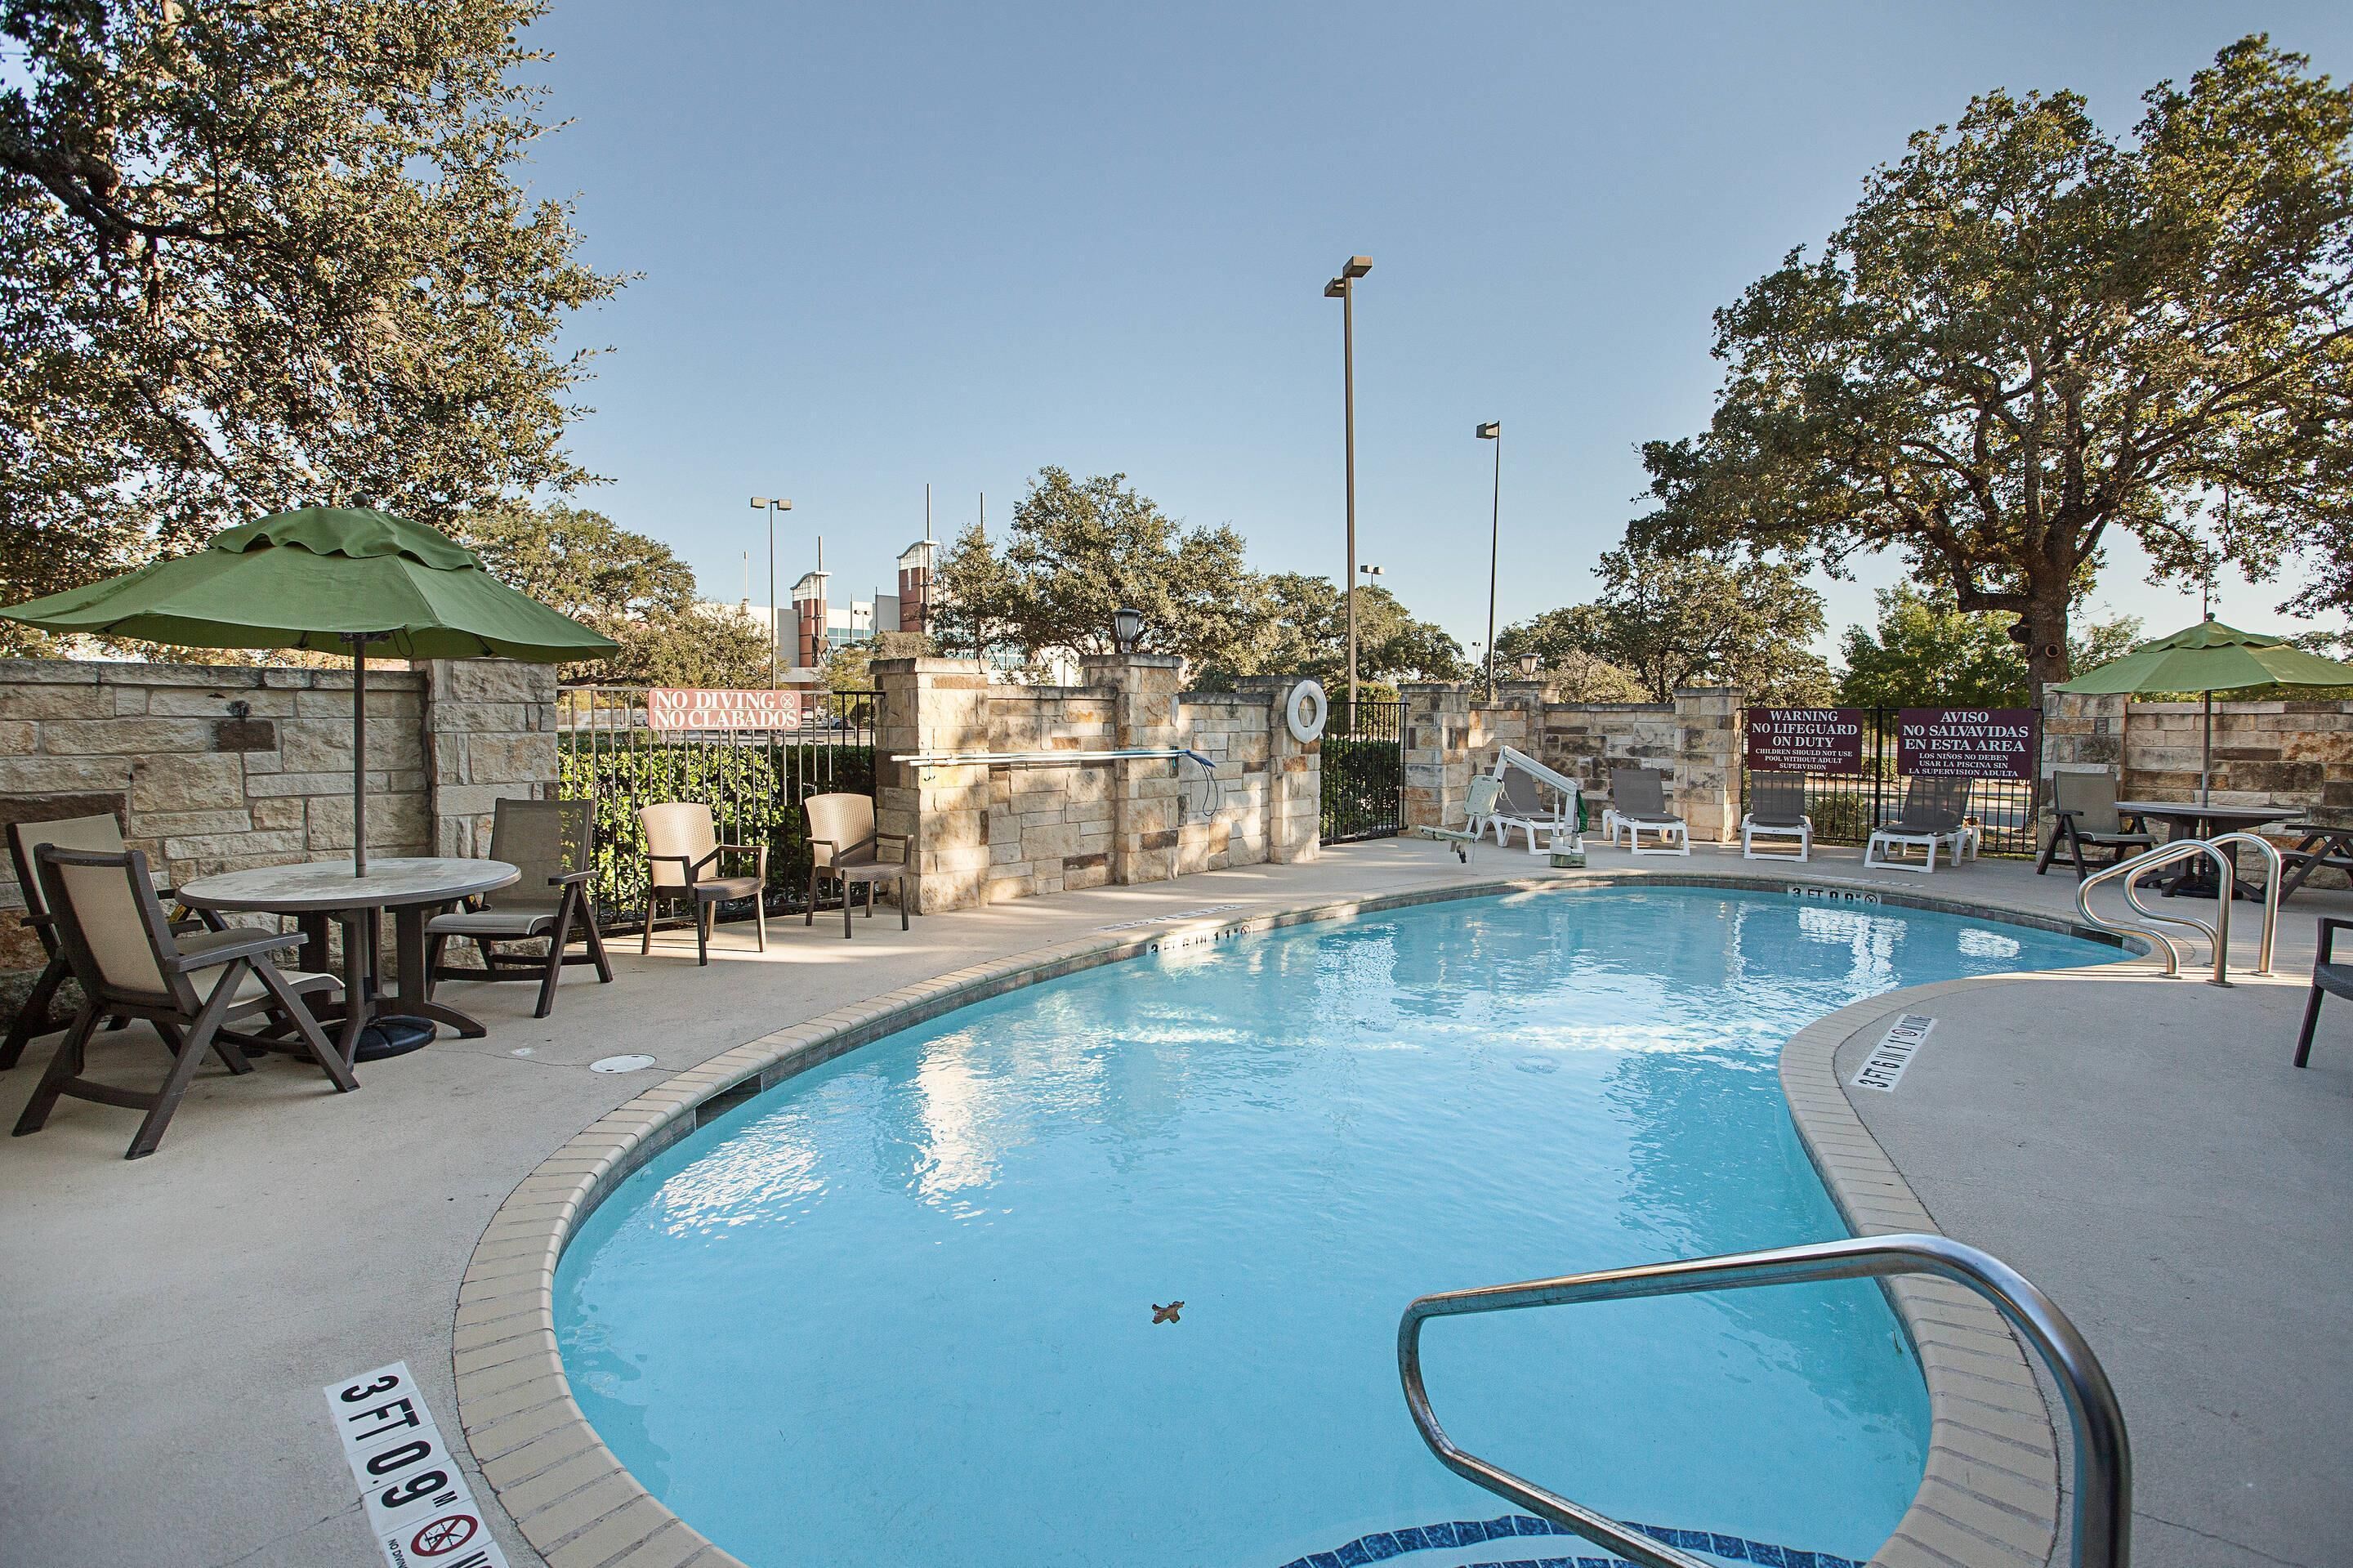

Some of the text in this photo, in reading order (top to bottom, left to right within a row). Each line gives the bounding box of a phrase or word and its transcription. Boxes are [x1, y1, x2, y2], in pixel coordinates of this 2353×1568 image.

[654, 691, 775, 709] NO DIVING
[654, 710, 797, 728] NO CLABADOS
[1770, 711, 1837, 721] WARNING
[1940, 712, 1989, 722] AVISO
[1752, 723, 1857, 735] NO LIFEGUARD
[1903, 726, 2028, 737] NO SALVAVIDAS
[1773, 736, 1834, 748] ON DUTY
[1904, 739, 2026, 752] EN ESTA AREA
[1863, 1068, 1895, 1080] FT
[1859, 1079, 1888, 1088] 3
[341, 1375, 399, 1402] 3
[349, 1397, 420, 1441] FT
[367, 1440, 448, 1508] 0.9
[388, 1539, 408, 1568] NO DIVIN
